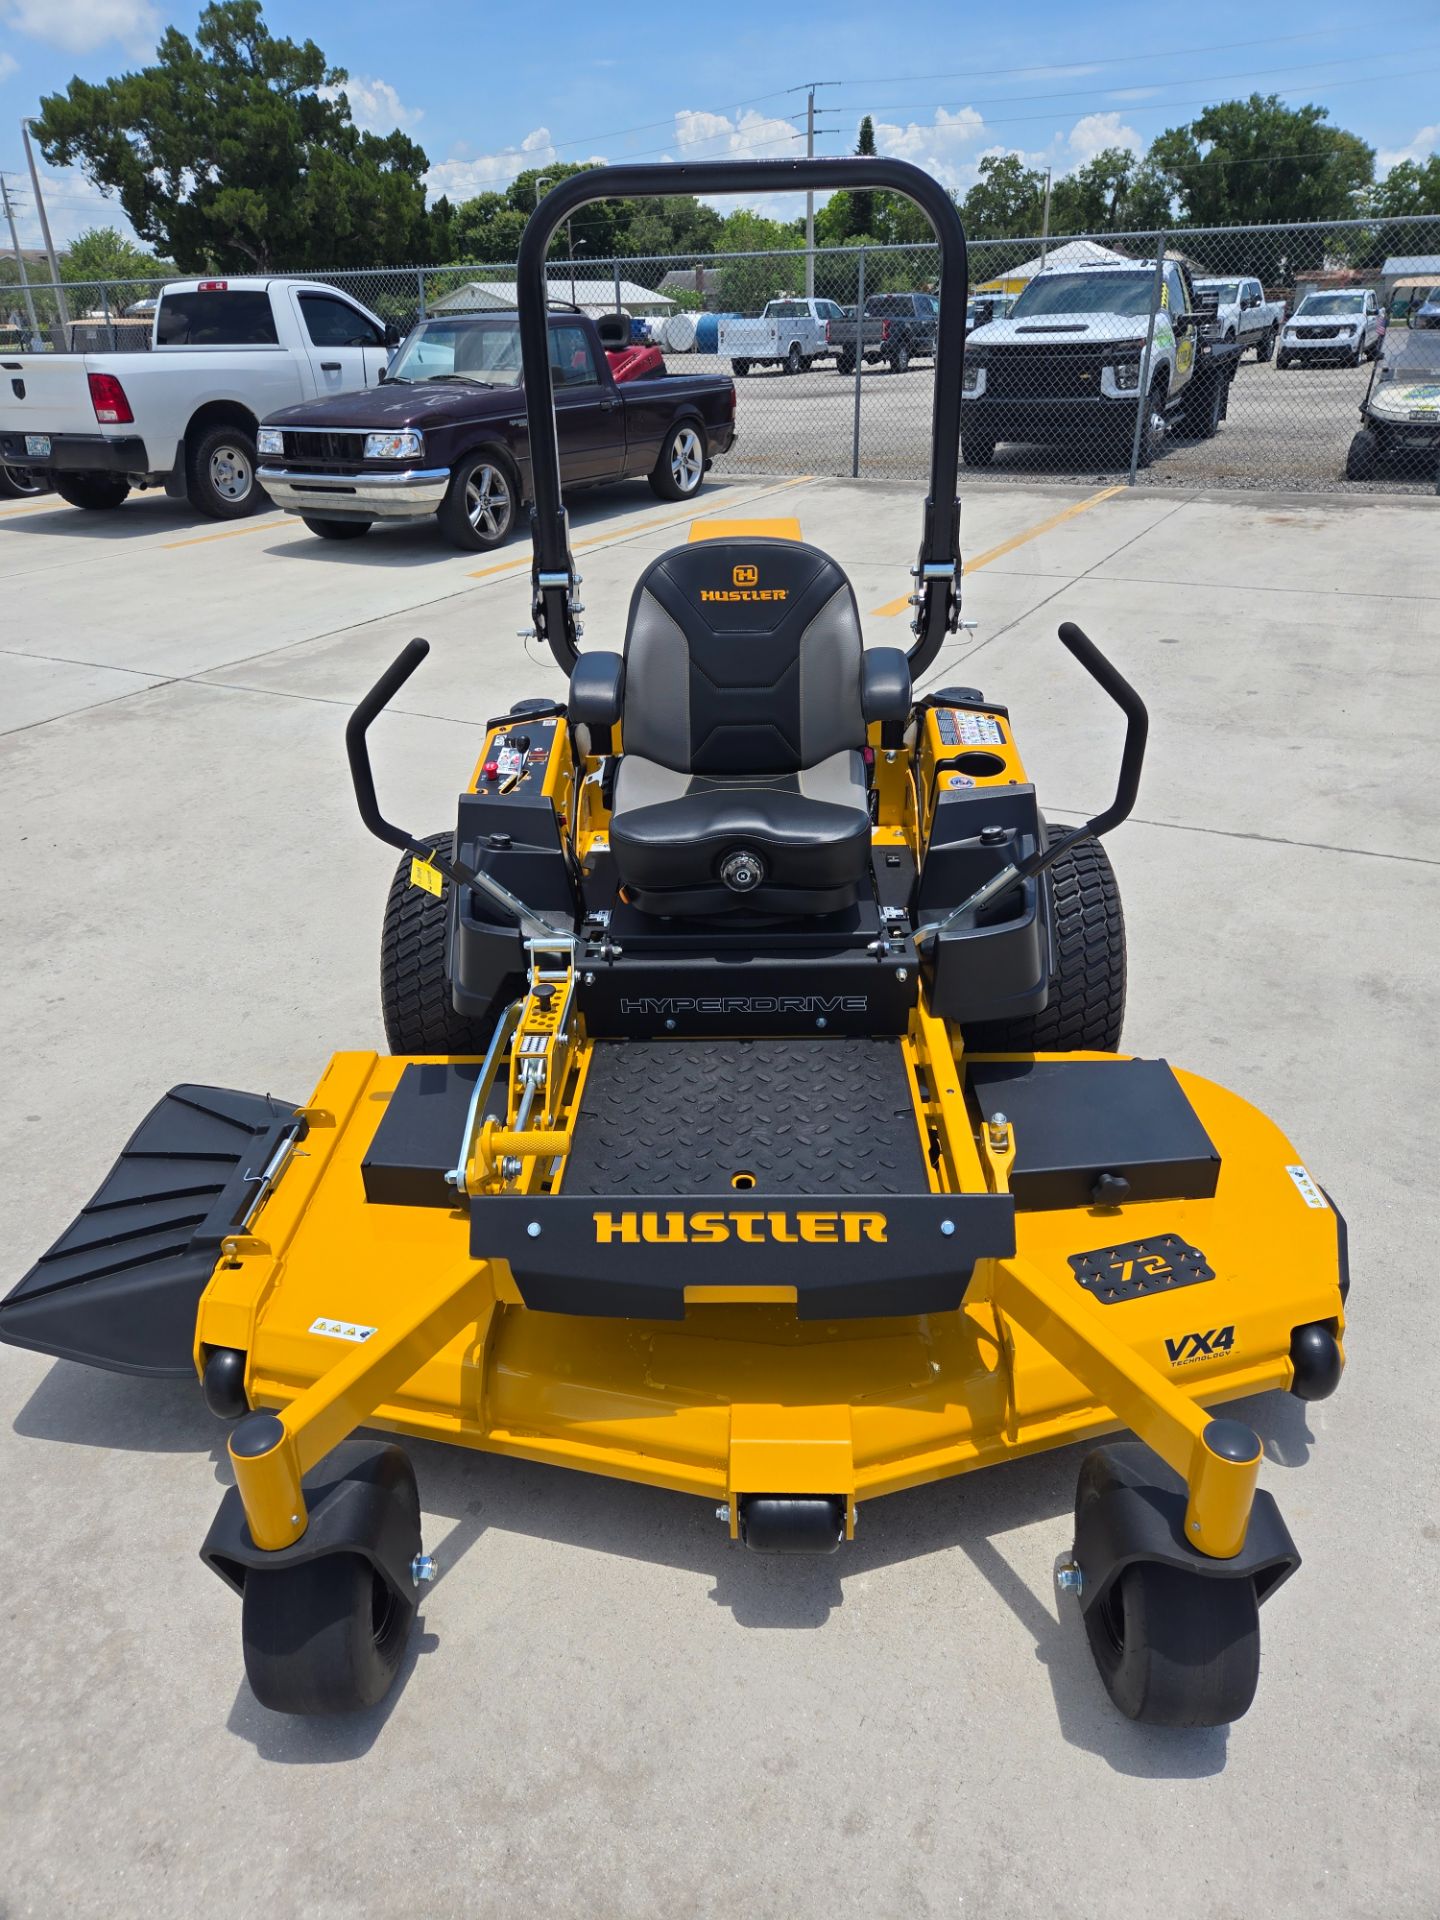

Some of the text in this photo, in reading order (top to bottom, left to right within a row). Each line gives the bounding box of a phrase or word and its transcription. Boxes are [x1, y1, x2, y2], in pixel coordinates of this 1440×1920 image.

[700, 590, 787, 602] HUSTLER
[620, 995, 868, 1014] HYPERDRIVE
[593, 1211, 888, 1243] HUSTLER
[1109, 1255, 1173, 1281] 72
[1164, 1325, 1235, 1362] VX4
[1171, 1350, 1231, 1367] TECHNOLOGY
